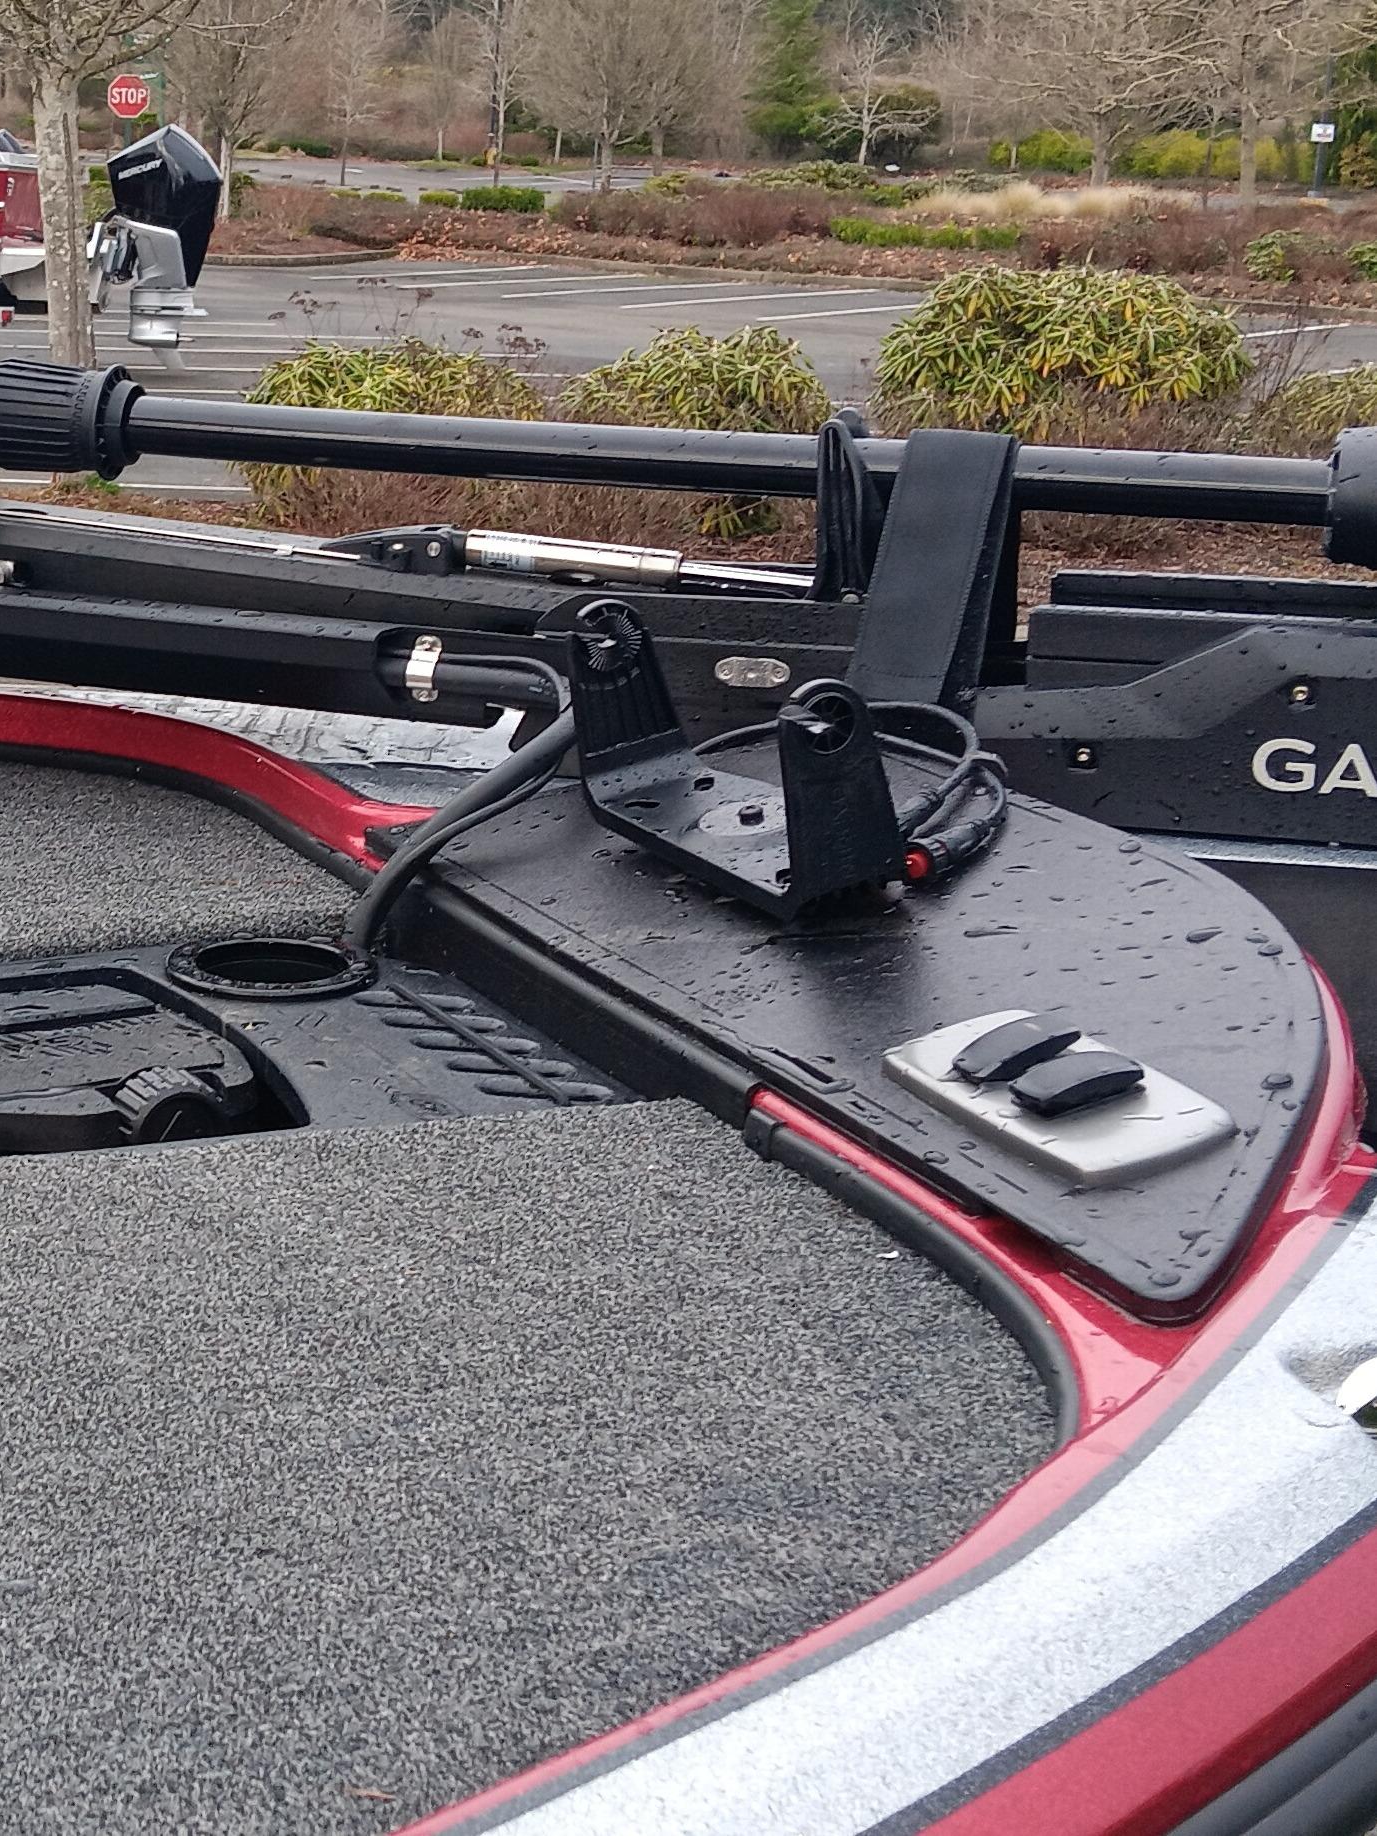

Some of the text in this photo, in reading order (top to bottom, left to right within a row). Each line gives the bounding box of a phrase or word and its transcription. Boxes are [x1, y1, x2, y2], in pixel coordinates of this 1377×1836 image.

[111, 87, 147, 104] STOP
[118, 158, 163, 180] MERCURY
[1251, 737, 1377, 799] GA
